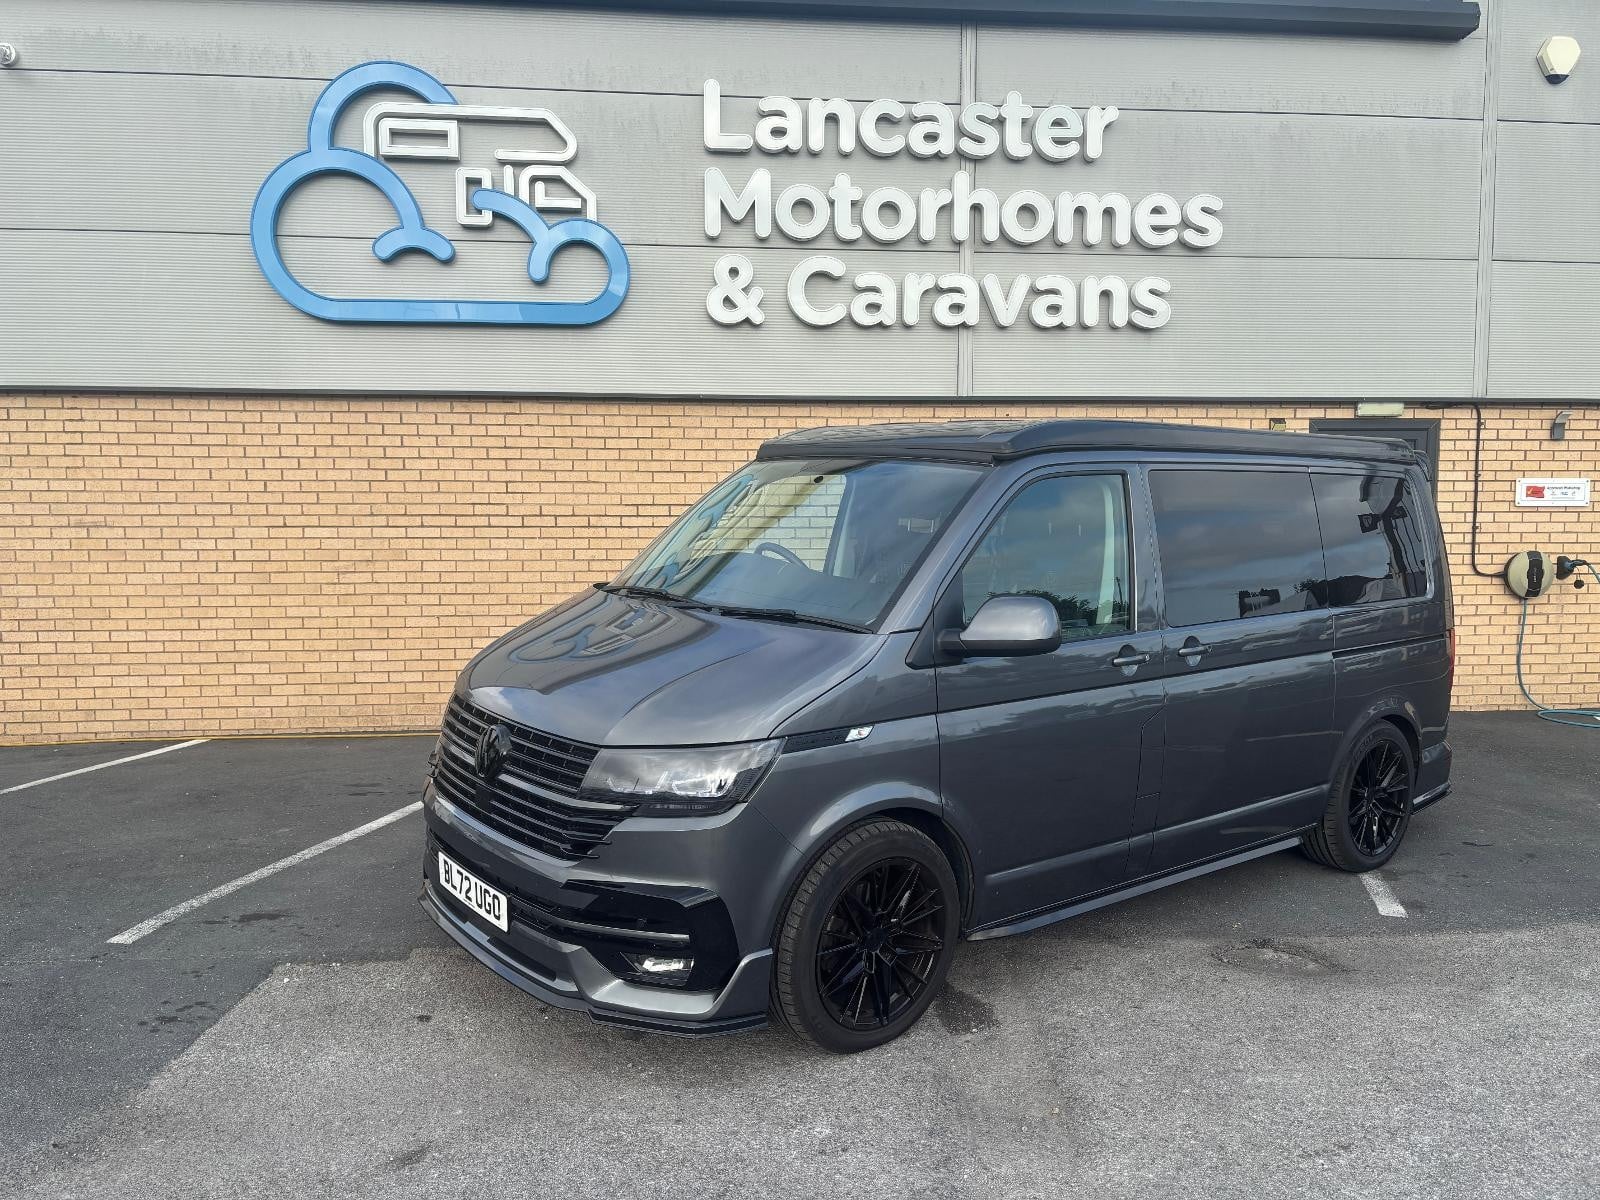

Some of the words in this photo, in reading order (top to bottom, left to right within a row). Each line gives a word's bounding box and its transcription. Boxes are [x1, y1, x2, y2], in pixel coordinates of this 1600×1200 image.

[704, 79, 1119, 162] Lancaster
[704, 167, 1223, 248] Motorhomes
[706, 254, 765, 326] &
[787, 255, 1172, 329] Caravans
[443, 859, 473, 903] BL72
[475, 881, 501, 921] UGO
